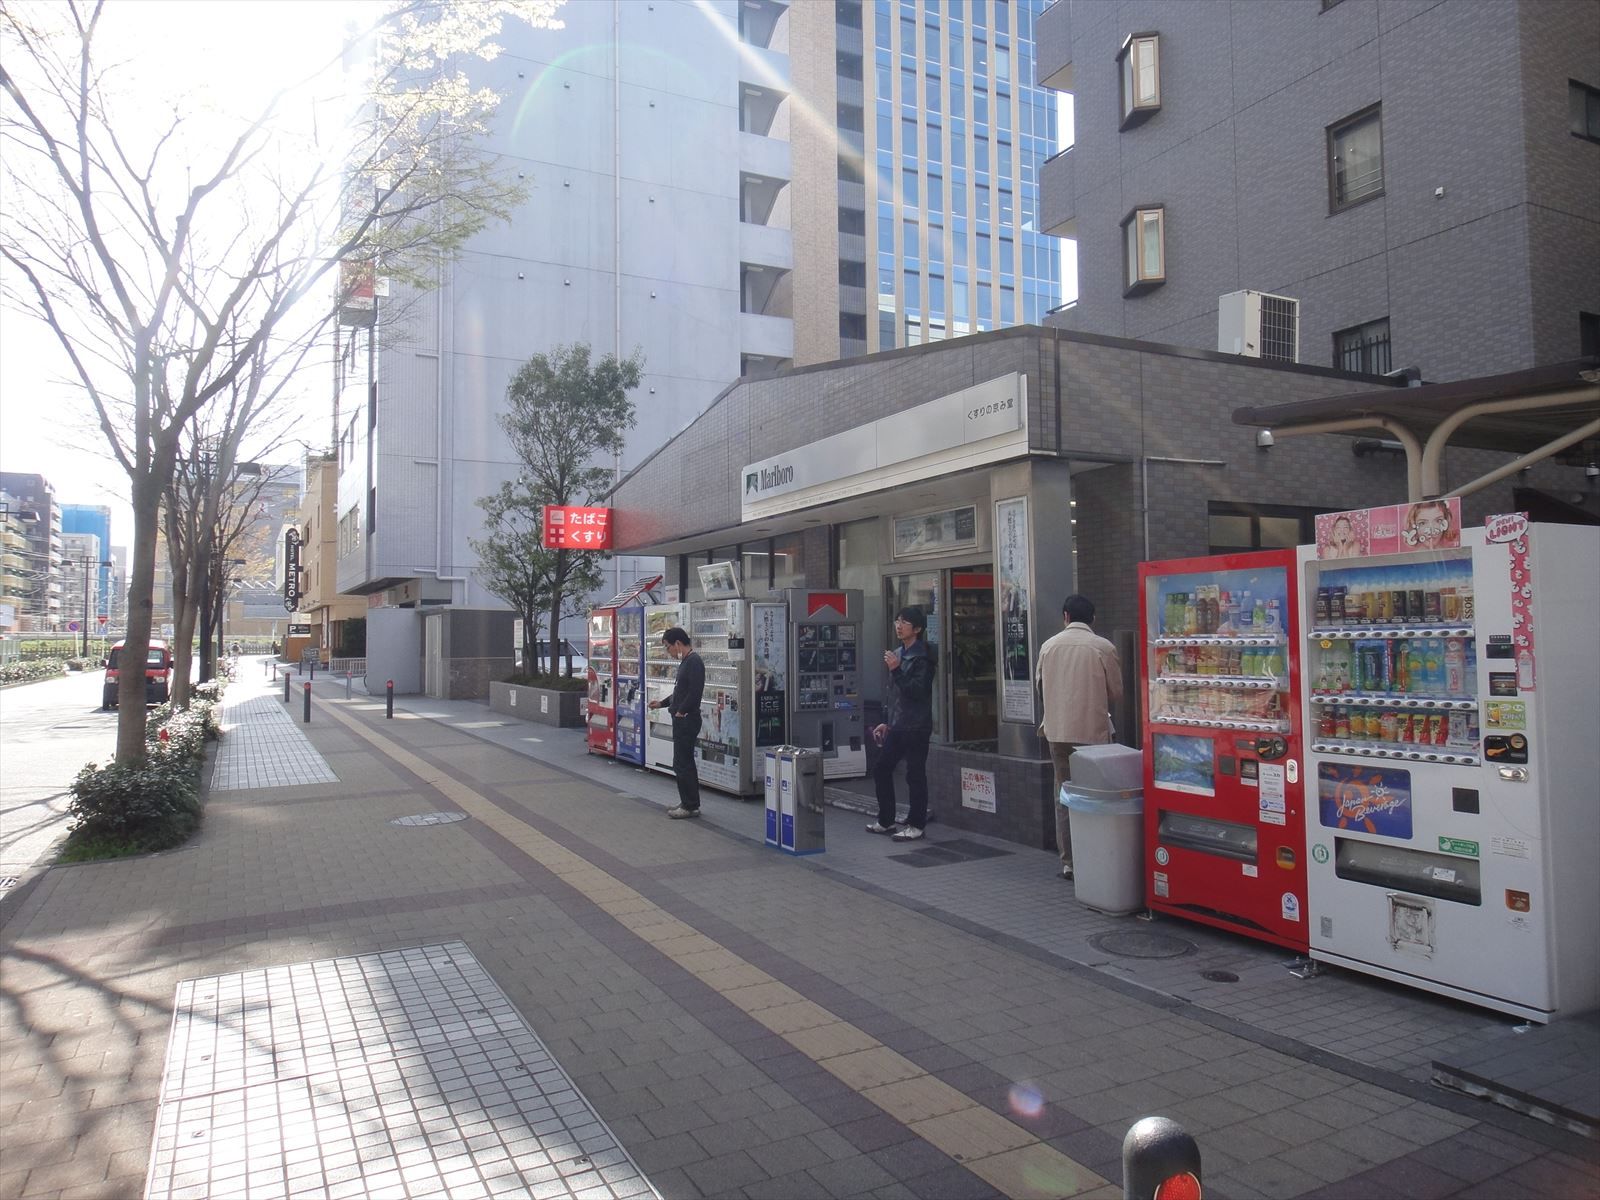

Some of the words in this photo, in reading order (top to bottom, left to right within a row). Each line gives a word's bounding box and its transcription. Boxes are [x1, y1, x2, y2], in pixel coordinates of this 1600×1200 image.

[760, 464, 794, 490] Marlboro
[570, 512, 607, 526] たばこ
[1489, 519, 1526, 539] LIGHT
[571, 530, 607, 543] くすり
[288, 563, 296, 597] METRO
[1464, 596, 1473, 620] BOSS
[1007, 623, 1024, 632] ICE
[1336, 793, 1374, 818] Japan
[1352, 798, 1407, 822] Beverage
